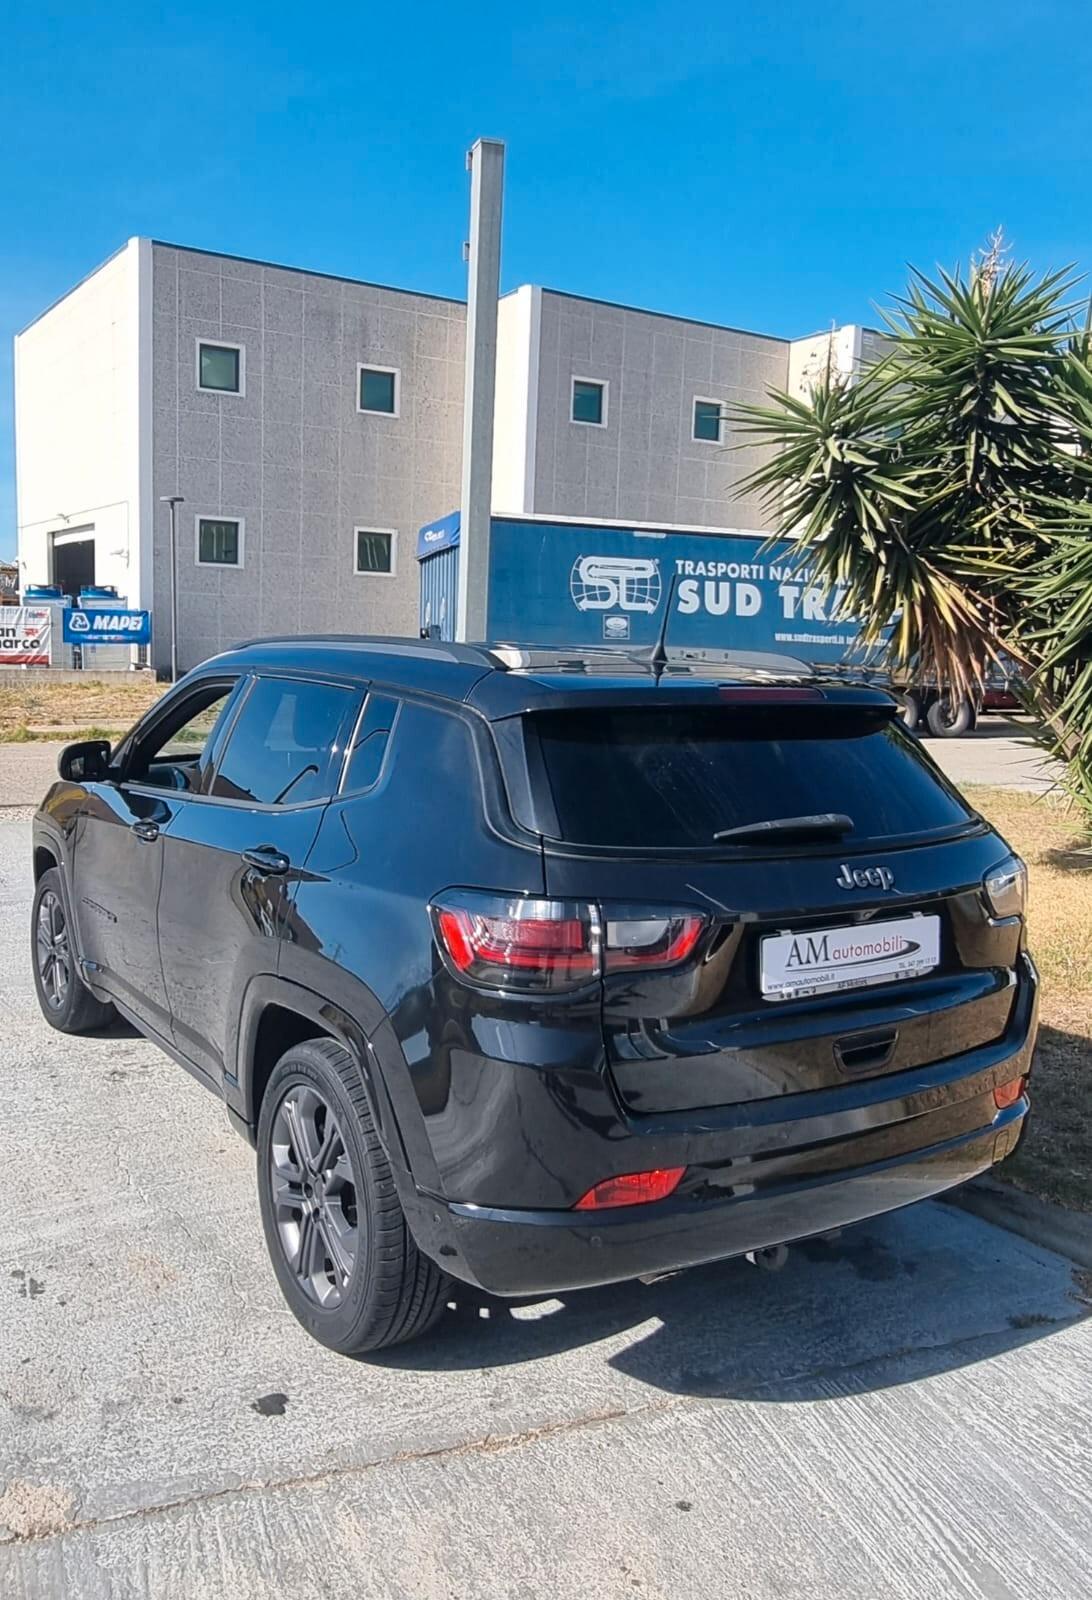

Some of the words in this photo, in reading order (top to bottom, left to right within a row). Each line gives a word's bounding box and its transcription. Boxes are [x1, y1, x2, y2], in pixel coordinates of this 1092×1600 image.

[675, 559, 764, 581] TRASPORTI
[677, 579, 762, 617] SUD
[92, 615, 144, 632] MAPEI
[0, 638, 41, 650] arco
[836, 864, 894, 891] Jeep
[785, 935, 831, 968] AM
[832, 936, 904, 961] automobili
